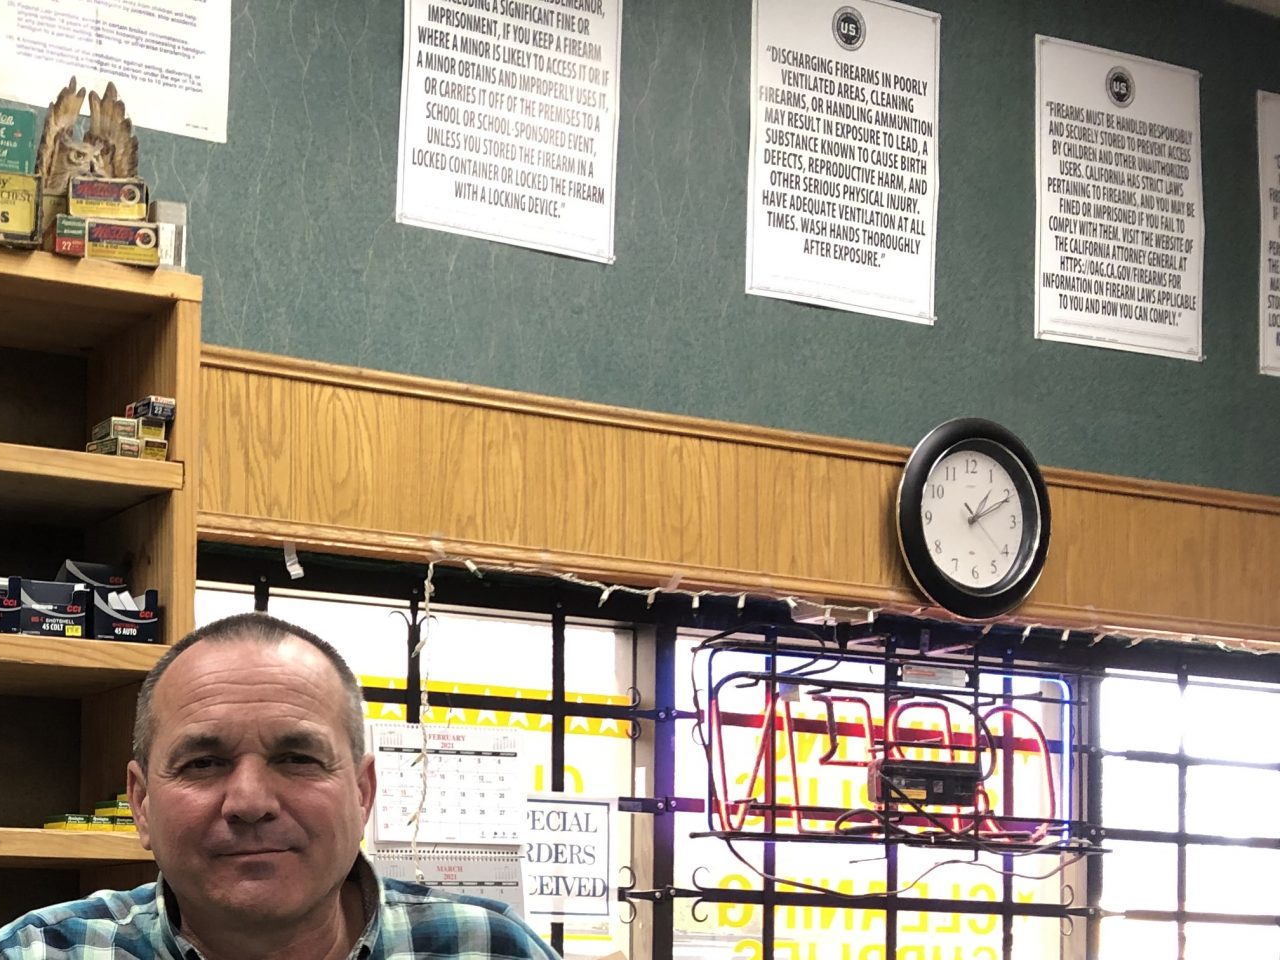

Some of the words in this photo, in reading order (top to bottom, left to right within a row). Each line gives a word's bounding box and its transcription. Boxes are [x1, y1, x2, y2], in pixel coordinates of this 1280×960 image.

[840, 21, 856, 35] US
[835, 61, 879, 85] FIREARMS
[882, 72, 891, 88] IN
[894, 75, 926, 96] POORLY
[781, 69, 834, 95] VENTILATED
[837, 82, 868, 105] AREAS,
[870, 90, 913, 113] CLEANING
[1113, 81, 1127, 93] US
[759, 85, 808, 112] FIREARMS,
[811, 97, 823, 113] OR
[826, 100, 872, 123] HANDLING
[875, 111, 932, 136] AMMUNITION
[764, 107, 784, 125] MAY
[787, 112, 820, 132] RESULT
[823, 120, 832, 135] IN
[835, 122, 880, 145] EXPOSURE
[882, 132, 892, 148] TO
[896, 135, 920, 155] LEAD,
[923, 141, 928, 155] A
[765, 128, 818, 152] SUBSTANCE
[821, 139, 854, 160] KNOWN
[857, 147, 868, 163] TO
[871, 150, 898, 169] CAUSE
[901, 156, 926, 175] BIRTH
[412, 148, 445, 171] LOCKED
[449, 156, 498, 181] CONTAINER
[502, 167, 512, 184] OR
[515, 170, 547, 191] LOCKED
[550, 177, 565, 195] THE
[568, 181, 603, 204] FIREARM
[764, 148, 805, 173] DEFECTS,
[808, 157, 874, 184] REPRODUCTIVE
[877, 171, 905, 193] HARM,
[908, 178, 927, 195] AND
[454, 181, 477, 201] WITH
[480, 186, 485, 203] A
[488, 187, 525, 210] LOCKING
[770, 170, 800, 190] OTHER
[803, 177, 840, 198] SERIOUS
[843, 185, 884, 206] PHYSICAL
[887, 194, 919, 213] INJURY.
[762, 190, 786, 208] HAVE
[790, 195, 835, 218] ADEQUATE
[839, 205, 895, 229] VENTILATION
[897, 216, 907, 232] AT
[910, 219, 925, 235] ALL
[767, 211, 797, 231] TIMES.
[800, 218, 826, 236] WASH
[829, 223, 859, 242] HANDS
[862, 229, 919, 254] THOROUGHLY
[804, 239, 830, 258] AFTER
[1055, 236, 1067, 251] THE
[1070, 238, 1109, 258] CALIFORNIA
[1112, 245, 1145, 264] ATTORNEY
[1148, 252, 1176, 269] GENERAL
[1178, 257, 1186, 271] AT
[945, 466, 956, 481] 11
[965, 459, 978, 474] 12
[988, 468, 994, 483] 1
[931, 484, 944, 499] 10
[1003, 488, 1011, 503] 2
[925, 511, 932, 525] 9
[1009, 515, 1017, 529] 3
[934, 540, 942, 554] 8
[1001, 543, 1009, 557] 4
[951, 558, 959, 571] 7
[971, 565, 979, 579] 6
[990, 560, 998, 574] 5
[3, 598, 17, 607] CCI
[67, 605, 81, 613] CCI
[139, 610, 154, 619] CCI
[42, 623, 49, 631] 45
[50, 624, 64, 632] COLT
[114, 627, 122, 635] 45
[122, 628, 138, 636] AUTO
[428, 733, 466, 741] FEBRUARY
[527, 809, 598, 833] ECIAL
[436, 865, 463, 873] MARCH
